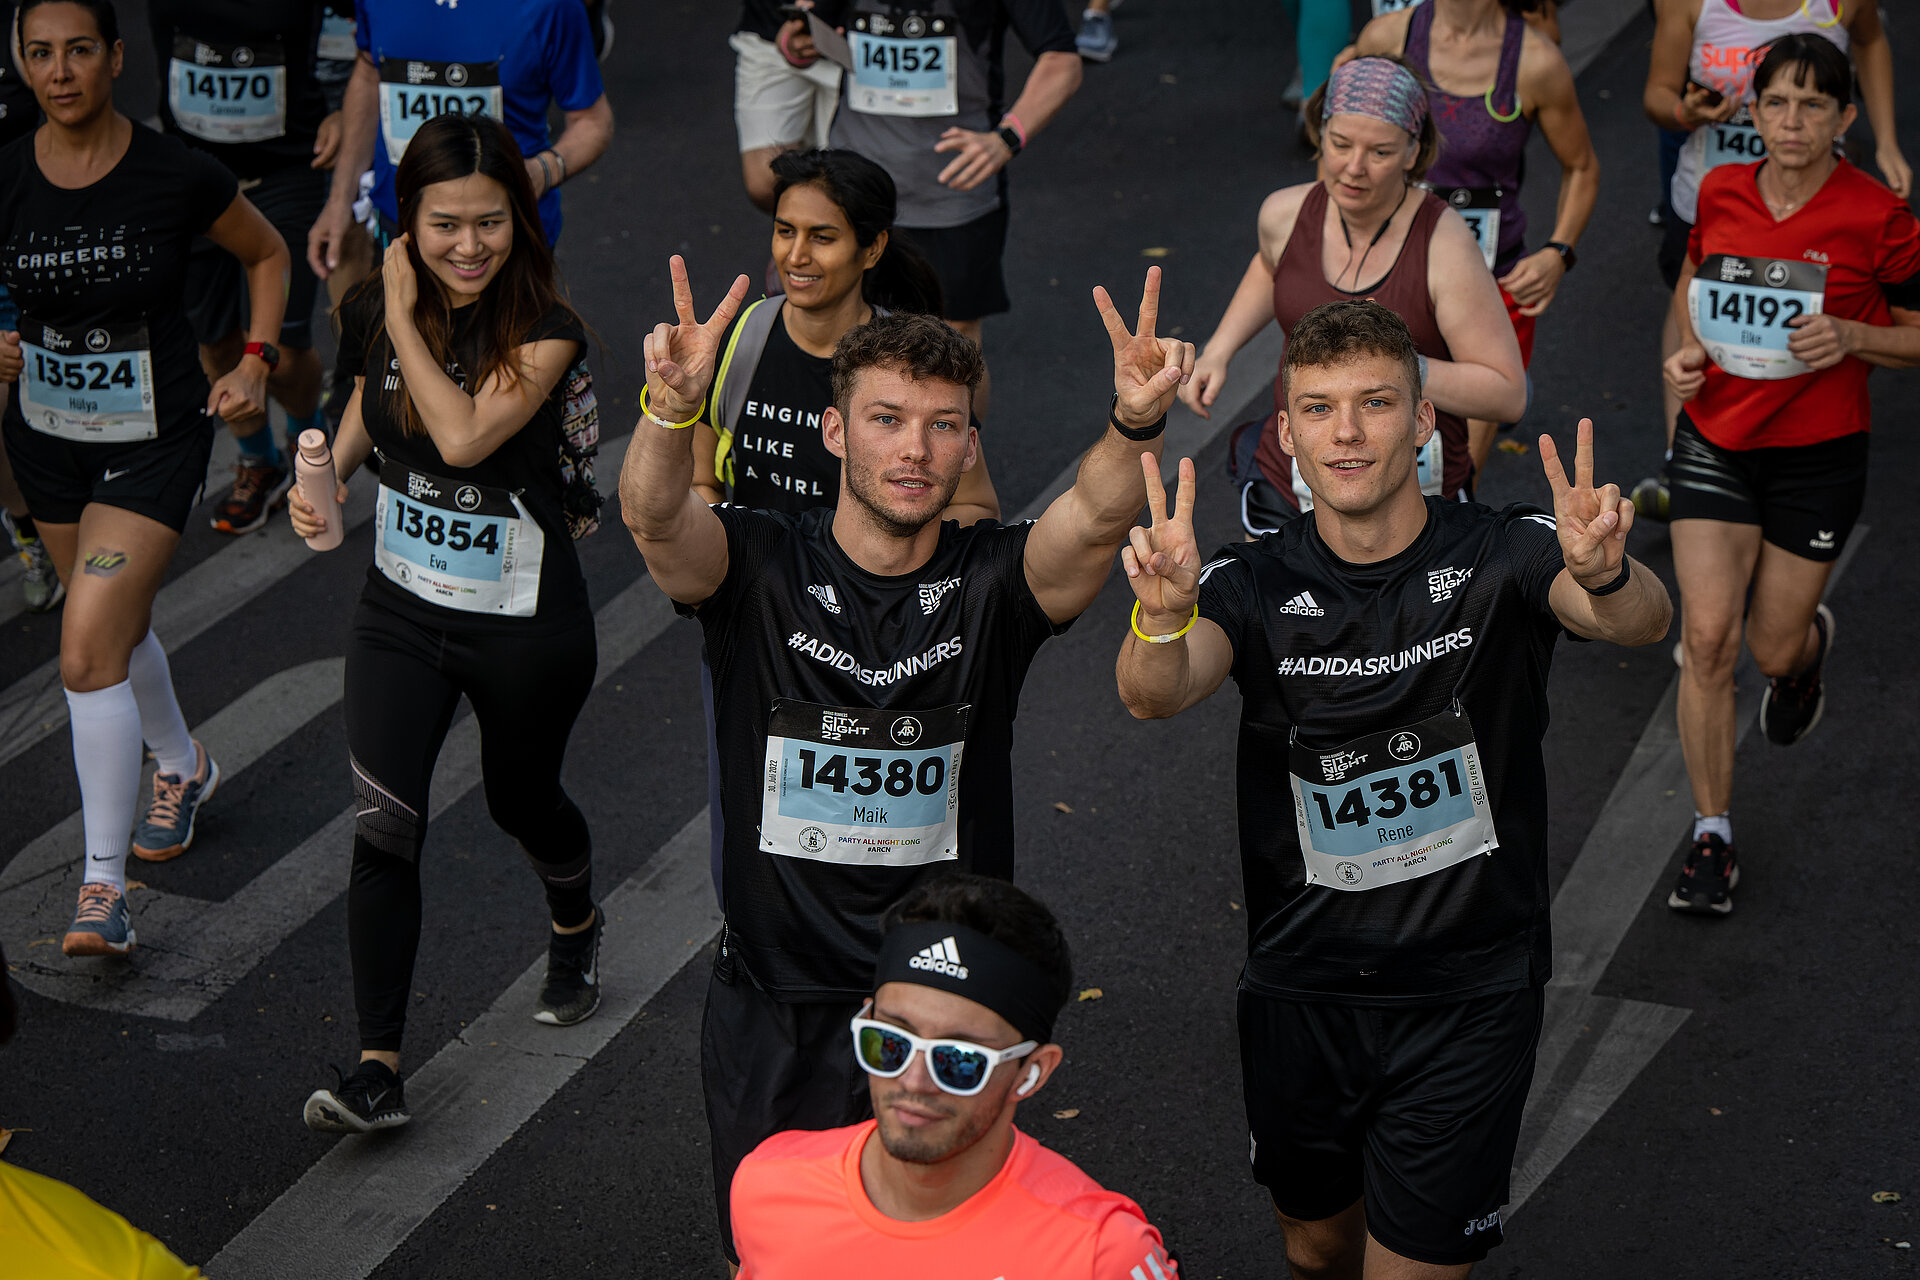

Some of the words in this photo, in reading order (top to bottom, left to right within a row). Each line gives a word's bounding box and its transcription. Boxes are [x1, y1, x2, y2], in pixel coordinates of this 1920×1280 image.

[863, 41, 942, 72] 14152
[186, 69, 271, 100] 14170
[1716, 129, 1766, 156] 140
[17, 245, 126, 269] CAREERS
[1708, 289, 1804, 329] 14192
[35, 352, 136, 391] 13524
[69, 397, 98, 413] Hülya
[746, 400, 820, 429] ENGIN
[743, 433, 795, 458] LIKE
[746, 465, 758, 479] A
[770, 472, 823, 495] GIRL
[396, 499, 499, 555] 13854
[429, 553, 447, 571] Eva
[1428, 568, 1466, 585] CITY
[1429, 567, 1474, 594] NIGHT
[807, 585, 842, 615] adidas
[1430, 590, 1453, 604] 22
[1279, 604, 1325, 617] adidas
[788, 631, 963, 686] #ADIDASRUNNERS
[1278, 627, 1473, 676] #ADIDASRUNNERS
[822, 715, 859, 727] CITY
[822, 721, 870, 735] NIGHT
[821, 731, 841, 741] 22
[1321, 750, 1355, 767] CITY
[1322, 754, 1368, 774] NIGHT
[1466, 754, 1479, 786] EVENTS
[799, 748, 946, 798] 14380
[1324, 771, 1346, 782] 22
[1312, 758, 1463, 831] 14381
[853, 805, 888, 824] Maik
[838, 836, 861, 845] PARTY
[900, 838, 921, 846] LONG
[1377, 824, 1415, 844] Rene
[1372, 856, 1396, 868] PARTY
[1397, 853, 1410, 862] ALL
[1410, 845, 1432, 858] NIGHT
[1433, 837, 1453, 850] LONG
[1404, 855, 1427, 868] #ARCN
[909, 955, 969, 980] adidas
